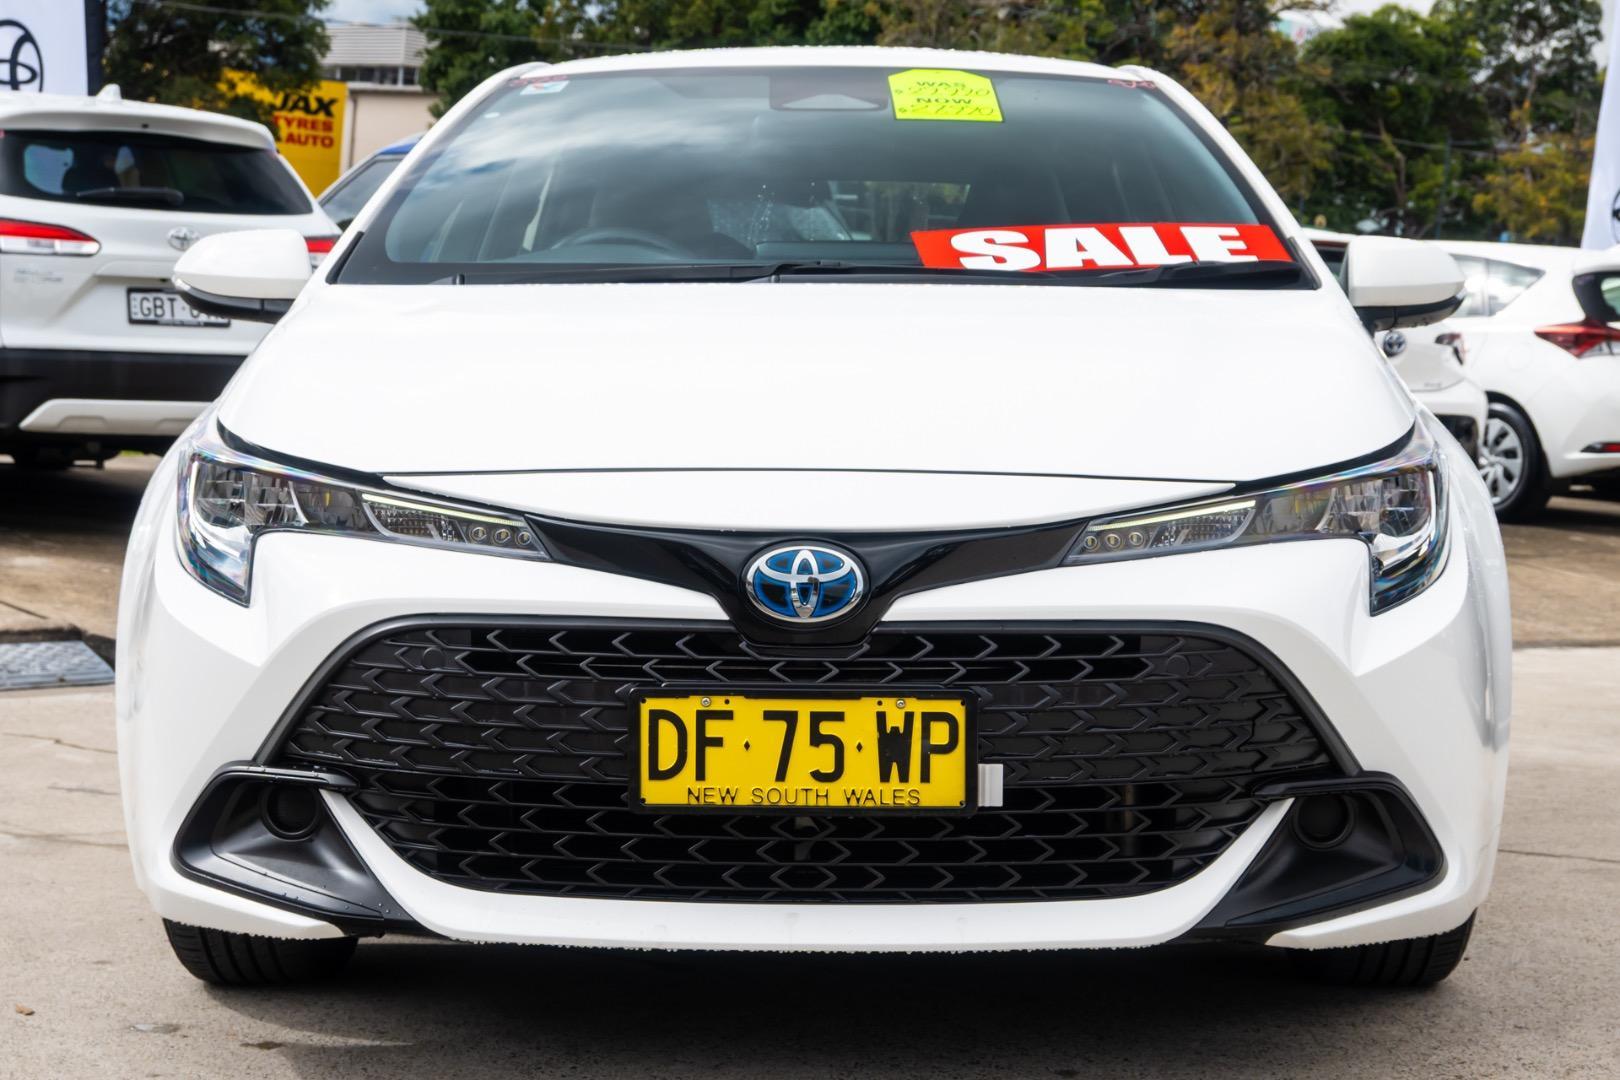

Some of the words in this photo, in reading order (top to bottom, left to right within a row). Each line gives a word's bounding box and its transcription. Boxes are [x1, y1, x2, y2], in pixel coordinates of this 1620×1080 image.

[275, 91, 338, 117] JAX
[273, 115, 334, 132] TYRES
[285, 132, 334, 148] AUTO
[950, 226, 1257, 271] SALE
[140, 296, 176, 318] GBT
[648, 709, 734, 781] DF
[763, 710, 845, 782] 75
[876, 711, 959, 783] WP
[687, 787, 738, 805] NEW
[751, 788, 829, 806] SOUTH
[844, 788, 920, 806] WALES
